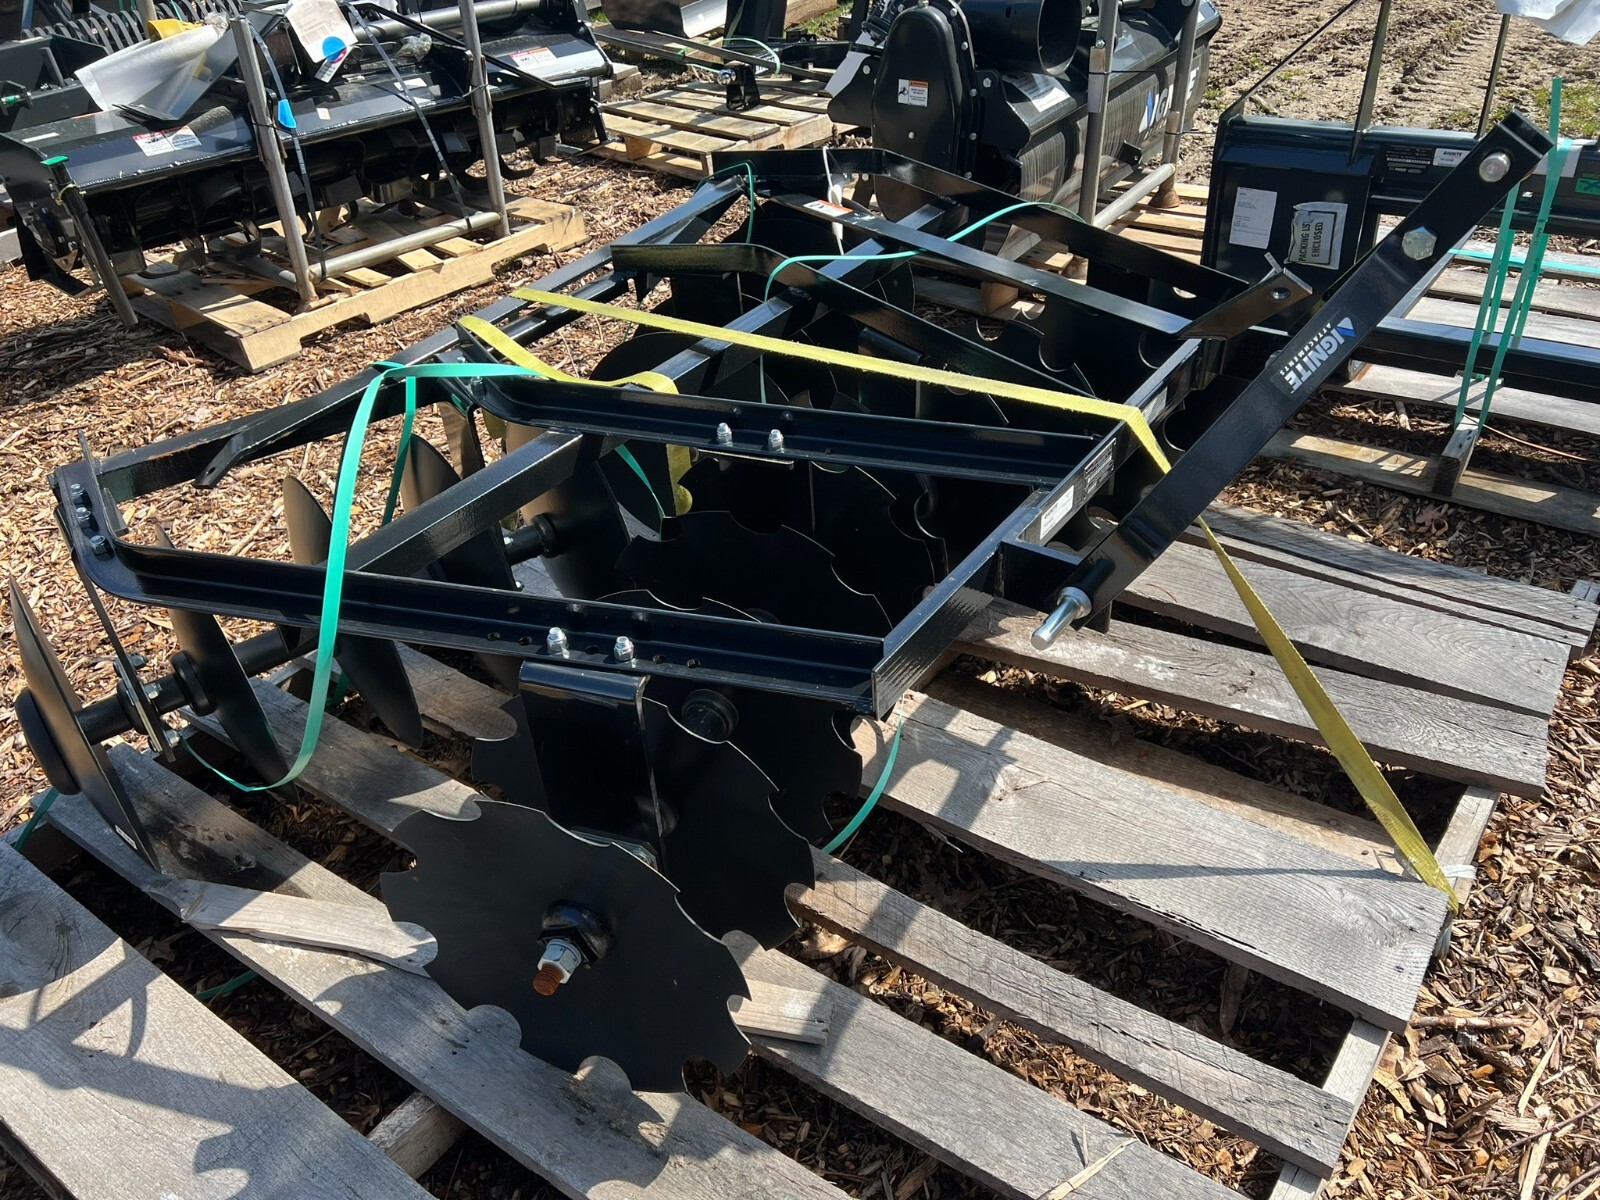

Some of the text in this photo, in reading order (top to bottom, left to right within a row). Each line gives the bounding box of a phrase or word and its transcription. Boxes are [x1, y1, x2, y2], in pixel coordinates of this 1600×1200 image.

[1149, 67, 1198, 127] IGNE
[1298, 233, 1310, 262] PACKING
[1311, 222, 1324, 257] ENCLOSED
[1279, 322, 1332, 376] ATTACHMENTS
[1284, 327, 1345, 391] IGNITE
